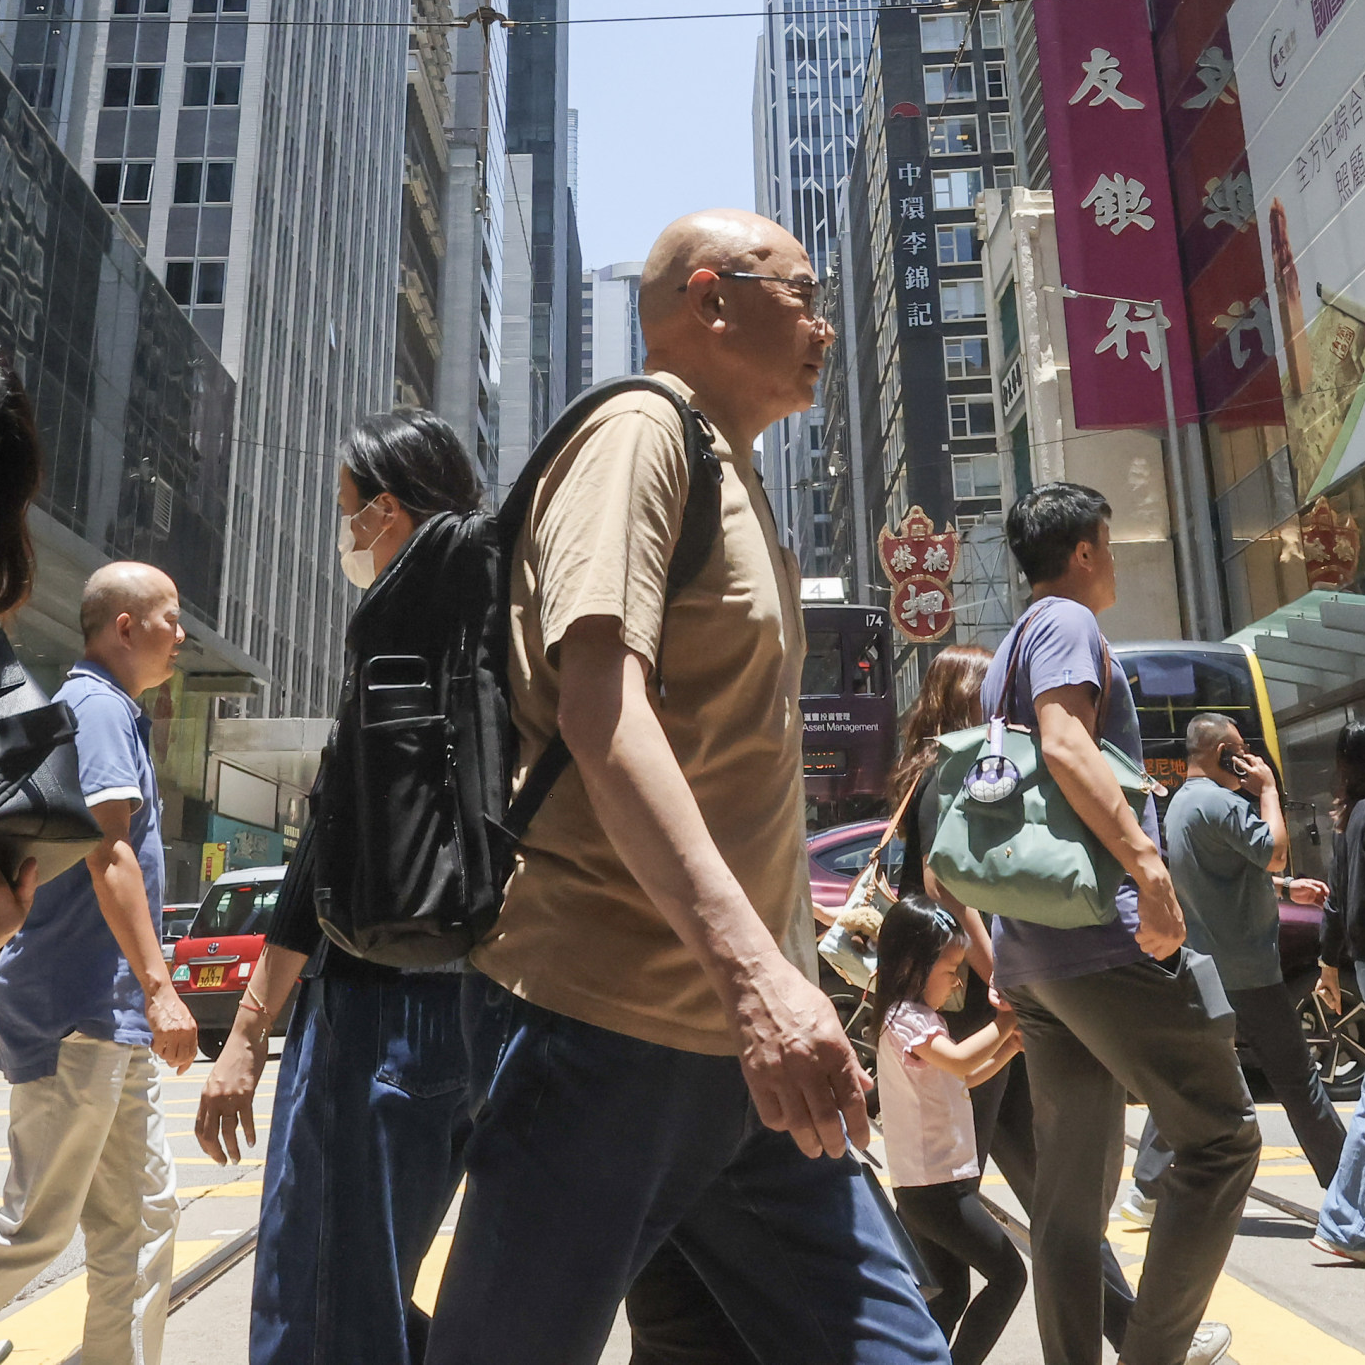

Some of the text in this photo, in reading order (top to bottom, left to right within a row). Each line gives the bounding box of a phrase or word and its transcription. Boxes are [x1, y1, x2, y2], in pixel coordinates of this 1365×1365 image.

[898, 162, 933, 328] 中環李錦記
[866, 614, 884, 627] 174
[802, 722, 879, 734] Asset Management
